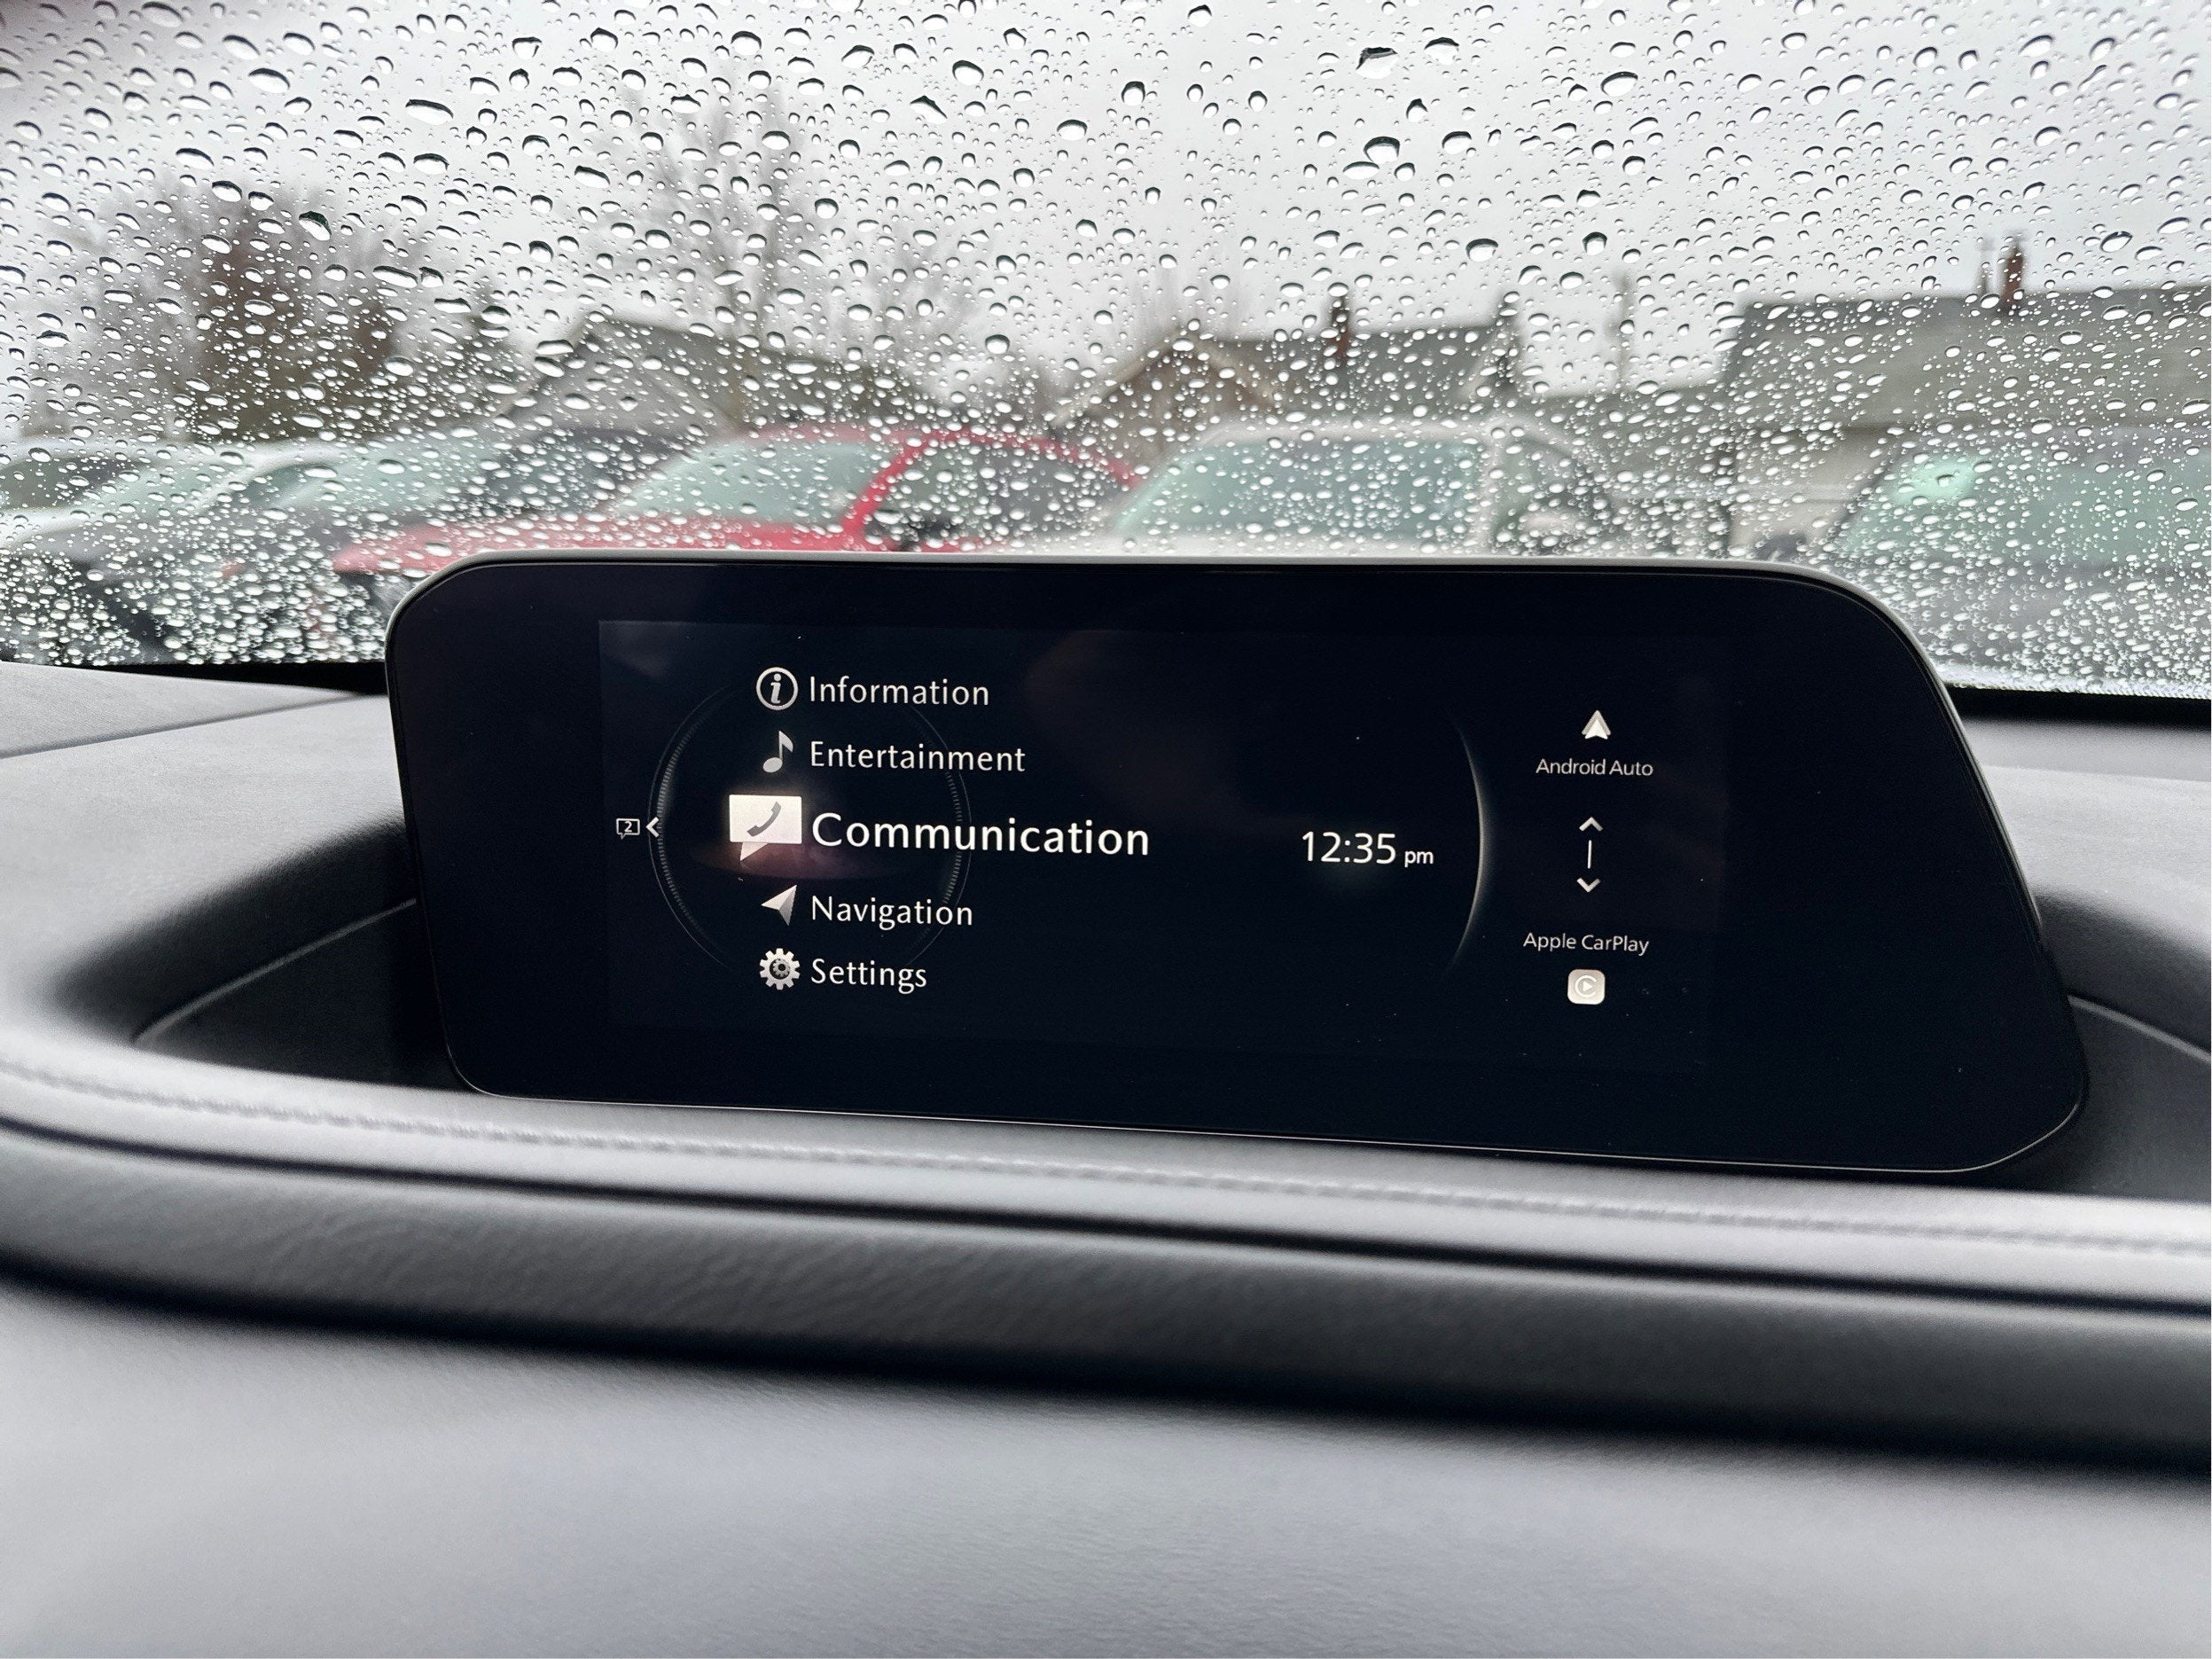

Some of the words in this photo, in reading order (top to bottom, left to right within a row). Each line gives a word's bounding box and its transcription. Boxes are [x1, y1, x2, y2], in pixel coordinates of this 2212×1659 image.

[809, 675, 989, 706] Information
[810, 740, 1026, 772] Entertainment
[1536, 757, 1606, 775] Android
[1608, 760, 1653, 776] Auto
[624, 820, 633, 833] 2
[812, 812, 1149, 856] Communication
[1301, 831, 1396, 865] 12:35
[1404, 850, 1434, 868] pm
[812, 895, 973, 931] Navigation
[1522, 932, 1576, 952] Apple
[1581, 935, 1649, 957] CarPlay
[810, 958, 927, 995] Settings
